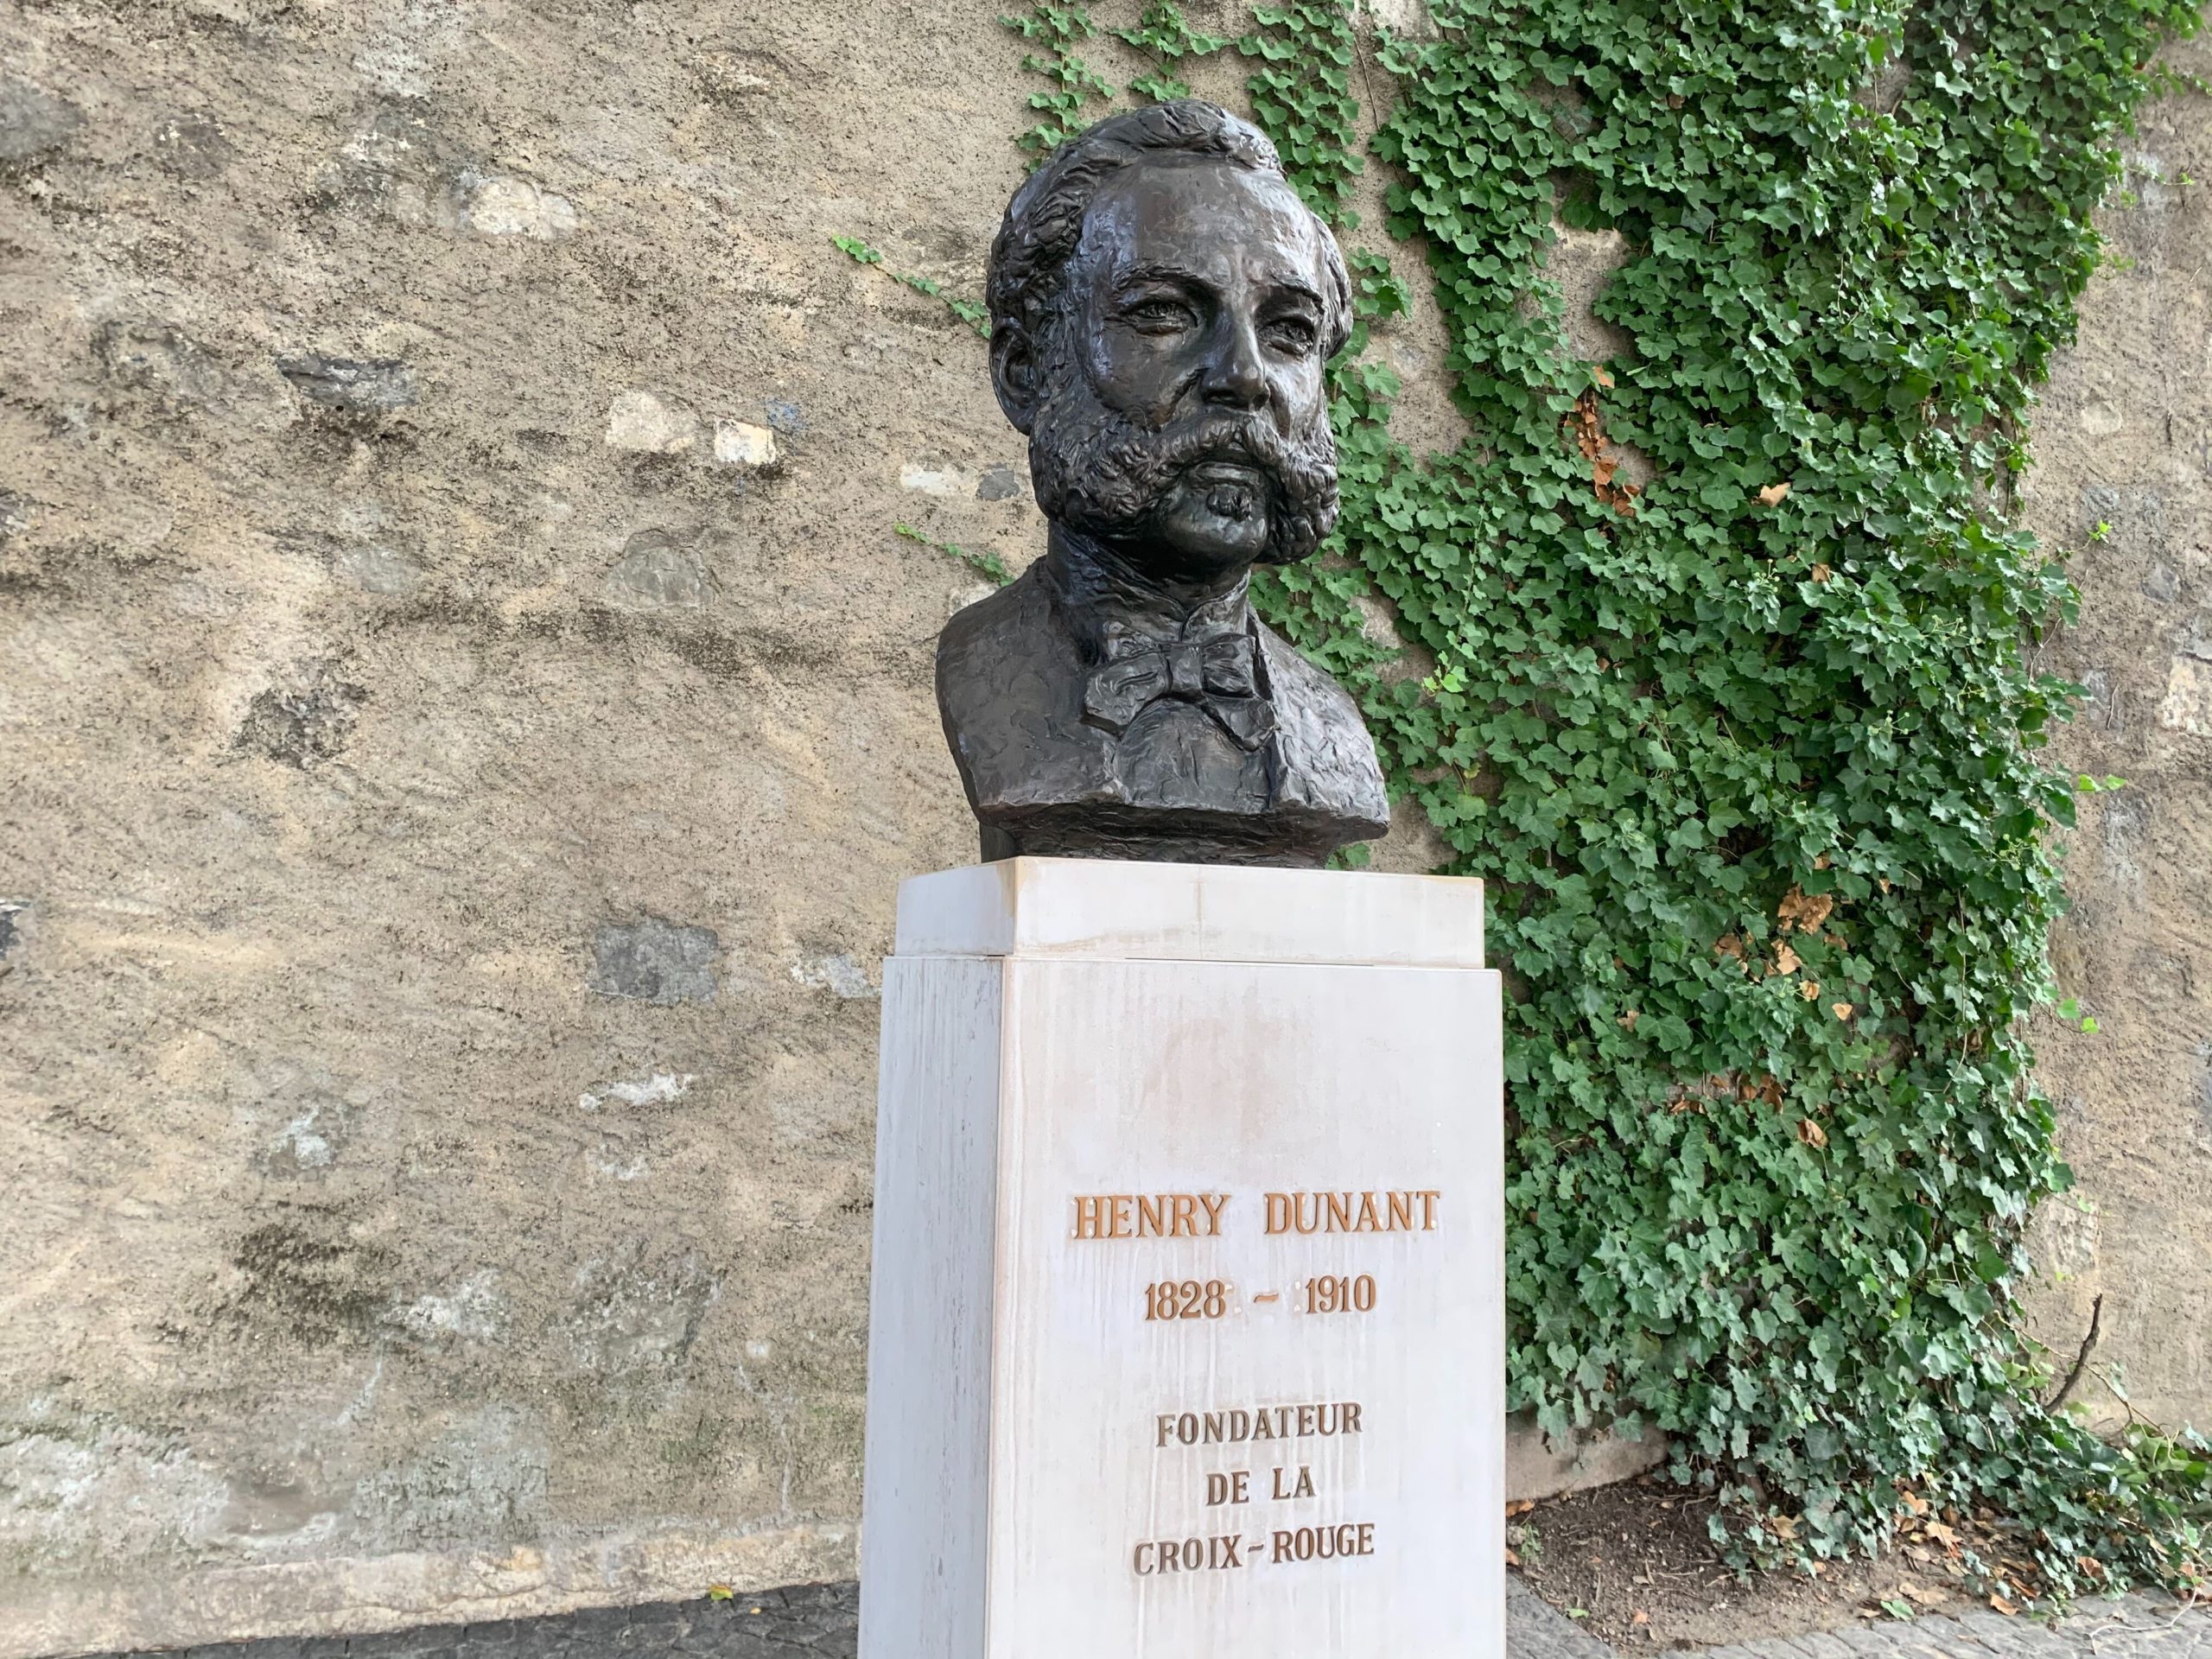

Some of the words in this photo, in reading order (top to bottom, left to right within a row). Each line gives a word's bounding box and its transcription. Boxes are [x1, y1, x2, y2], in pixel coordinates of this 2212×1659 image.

[1072, 1193, 1231, 1240] HENRY
[1264, 1191, 1440, 1236] DUNANT
[1145, 1280, 1225, 1320] 1828
[1306, 1274, 1376, 1314] 1910
[1156, 1402, 1363, 1447] FONDATEUR
[1206, 1471, 1249, 1506] DE
[1272, 1465, 1316, 1501] LA
[1134, 1523, 1376, 1576] CROIX-ROUGE
